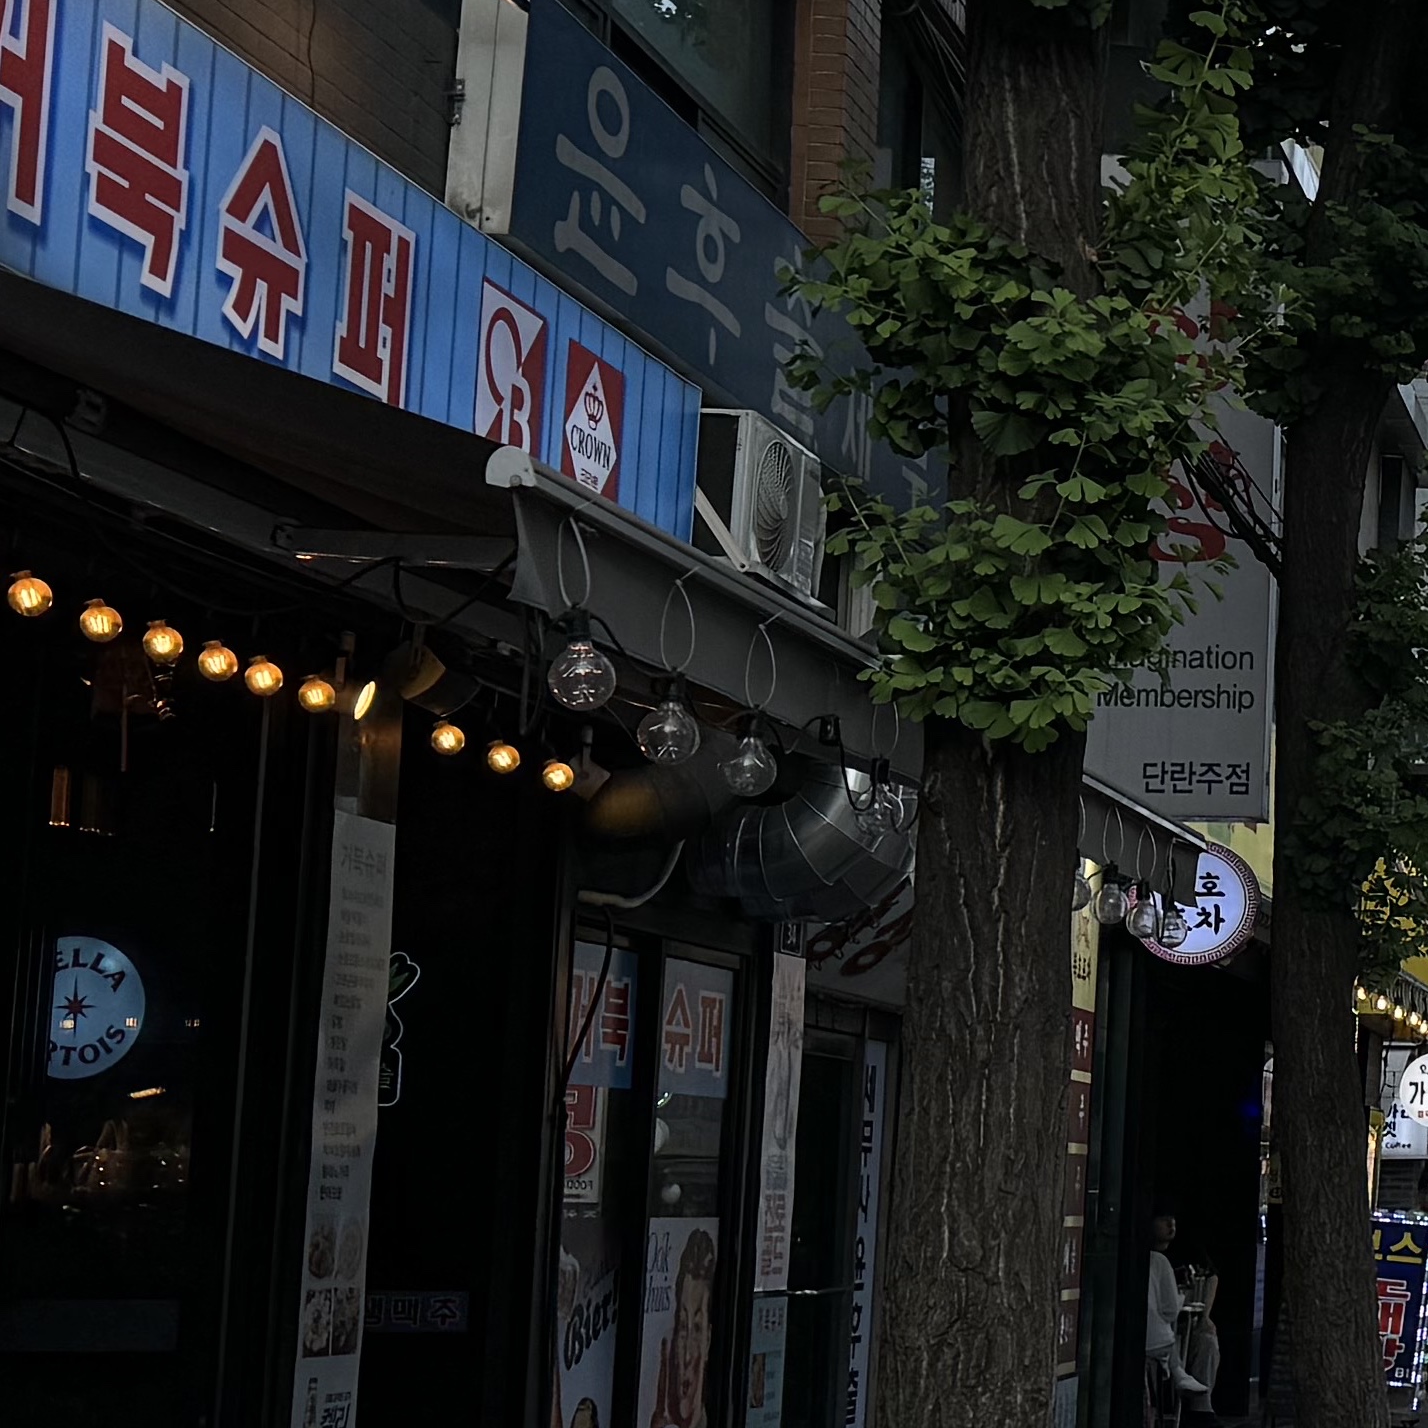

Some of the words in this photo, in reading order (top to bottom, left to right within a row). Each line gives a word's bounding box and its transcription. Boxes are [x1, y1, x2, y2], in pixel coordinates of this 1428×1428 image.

[569, 424, 611, 472] CROWN
[1097, 682, 1254, 713] Membership
[1142, 761, 1251, 796] 단란주점
[663, 983, 726, 1077] 슈퍼
[564, 1268, 620, 1371] Bier!
